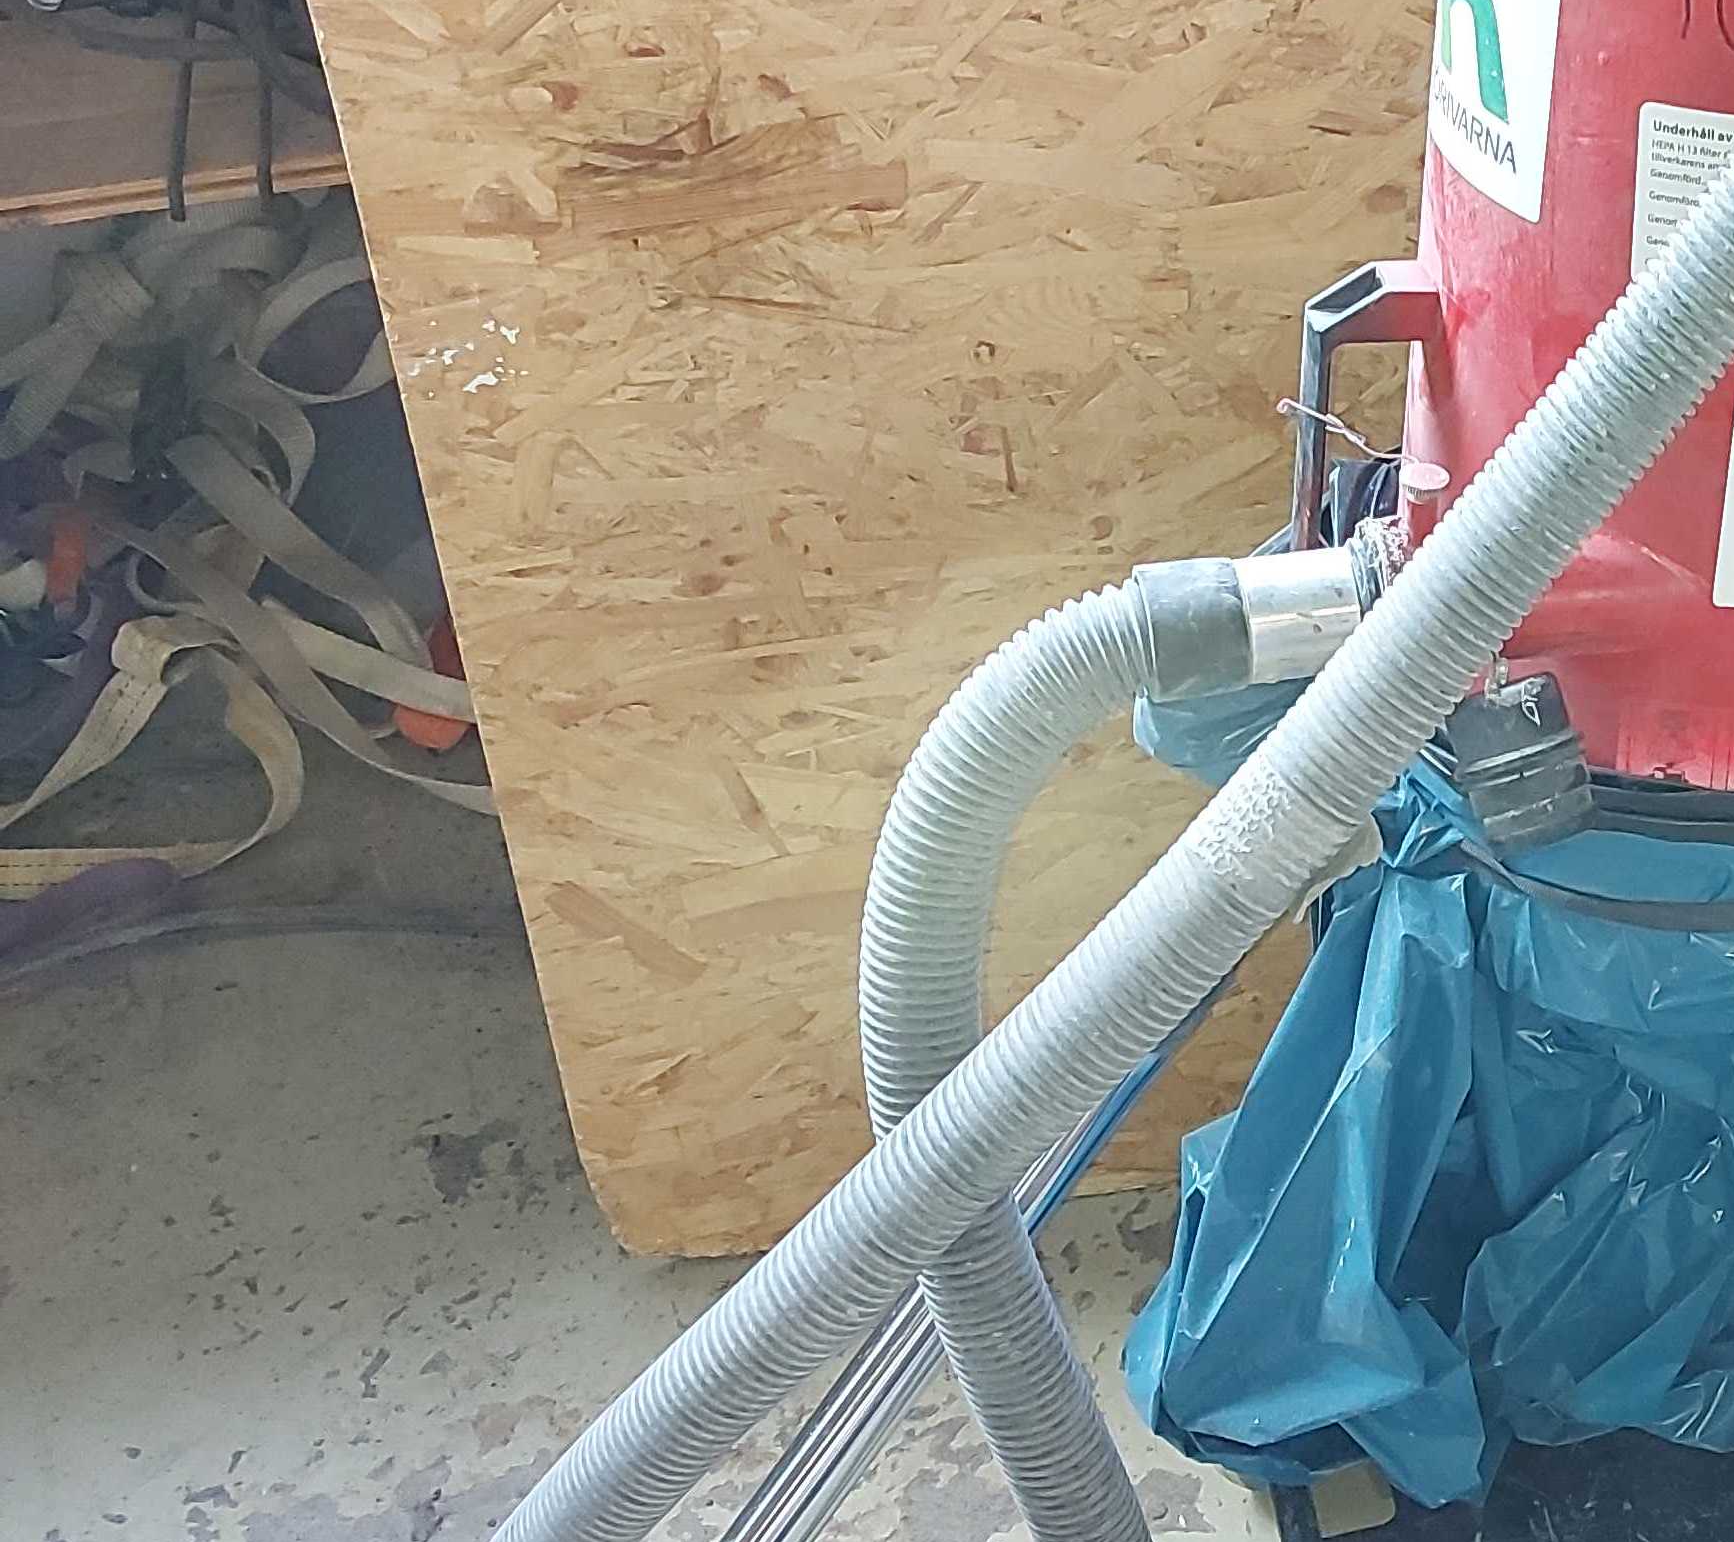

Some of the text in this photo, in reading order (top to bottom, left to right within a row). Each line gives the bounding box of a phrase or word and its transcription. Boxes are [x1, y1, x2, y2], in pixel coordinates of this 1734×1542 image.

[1653, 119, 1715, 141] Underhåll
[1717, 132, 1733, 143] av
[1651, 139, 1675, 152] HEPA
